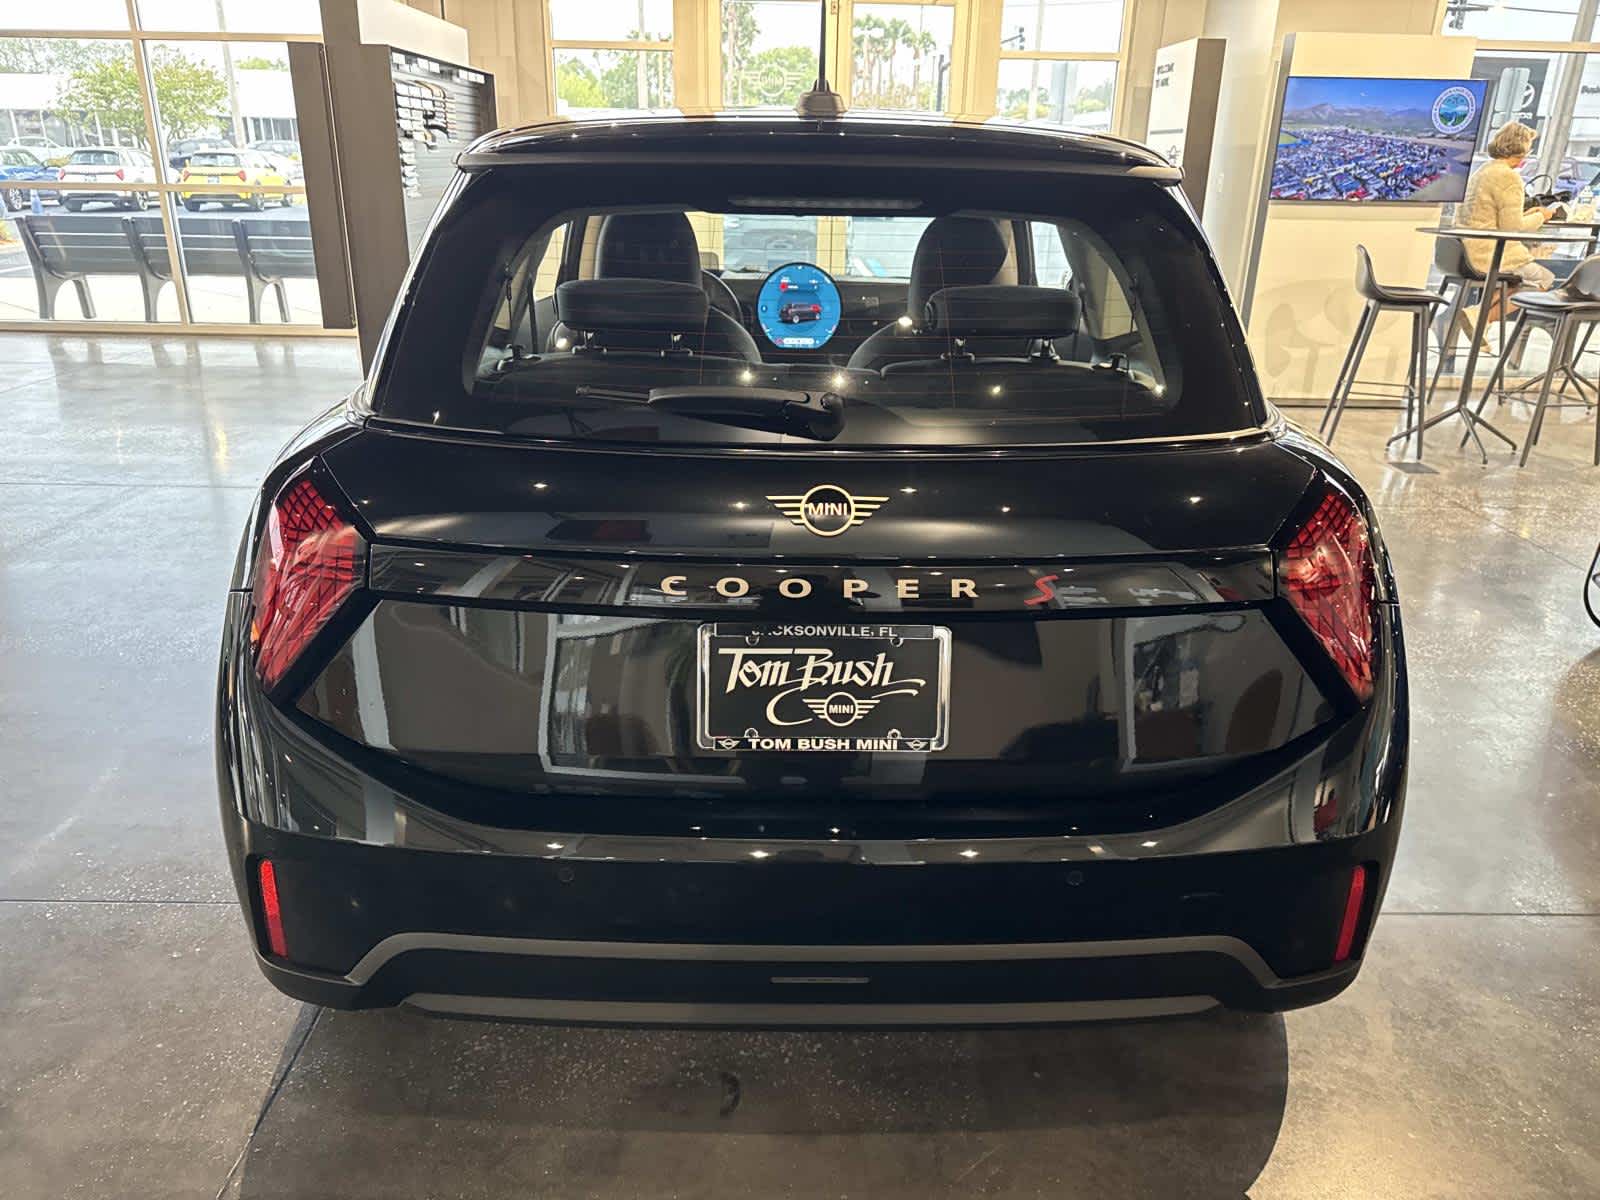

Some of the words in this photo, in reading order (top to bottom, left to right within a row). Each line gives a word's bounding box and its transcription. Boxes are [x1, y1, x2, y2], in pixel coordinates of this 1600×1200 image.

[808, 502, 848, 516] MINI
[660, 575, 979, 599] COOPER
[1023, 574, 1060, 606] S
[752, 625, 874, 637] CKSONVILLE,
[879, 626, 898, 637] FL
[718, 648, 794, 693] Tom
[788, 648, 926, 691] Bush
[829, 704, 854, 714] MINI
[749, 738, 791, 750] TOM
[797, 738, 850, 750] BUSH
[856, 738, 898, 750] MINI
